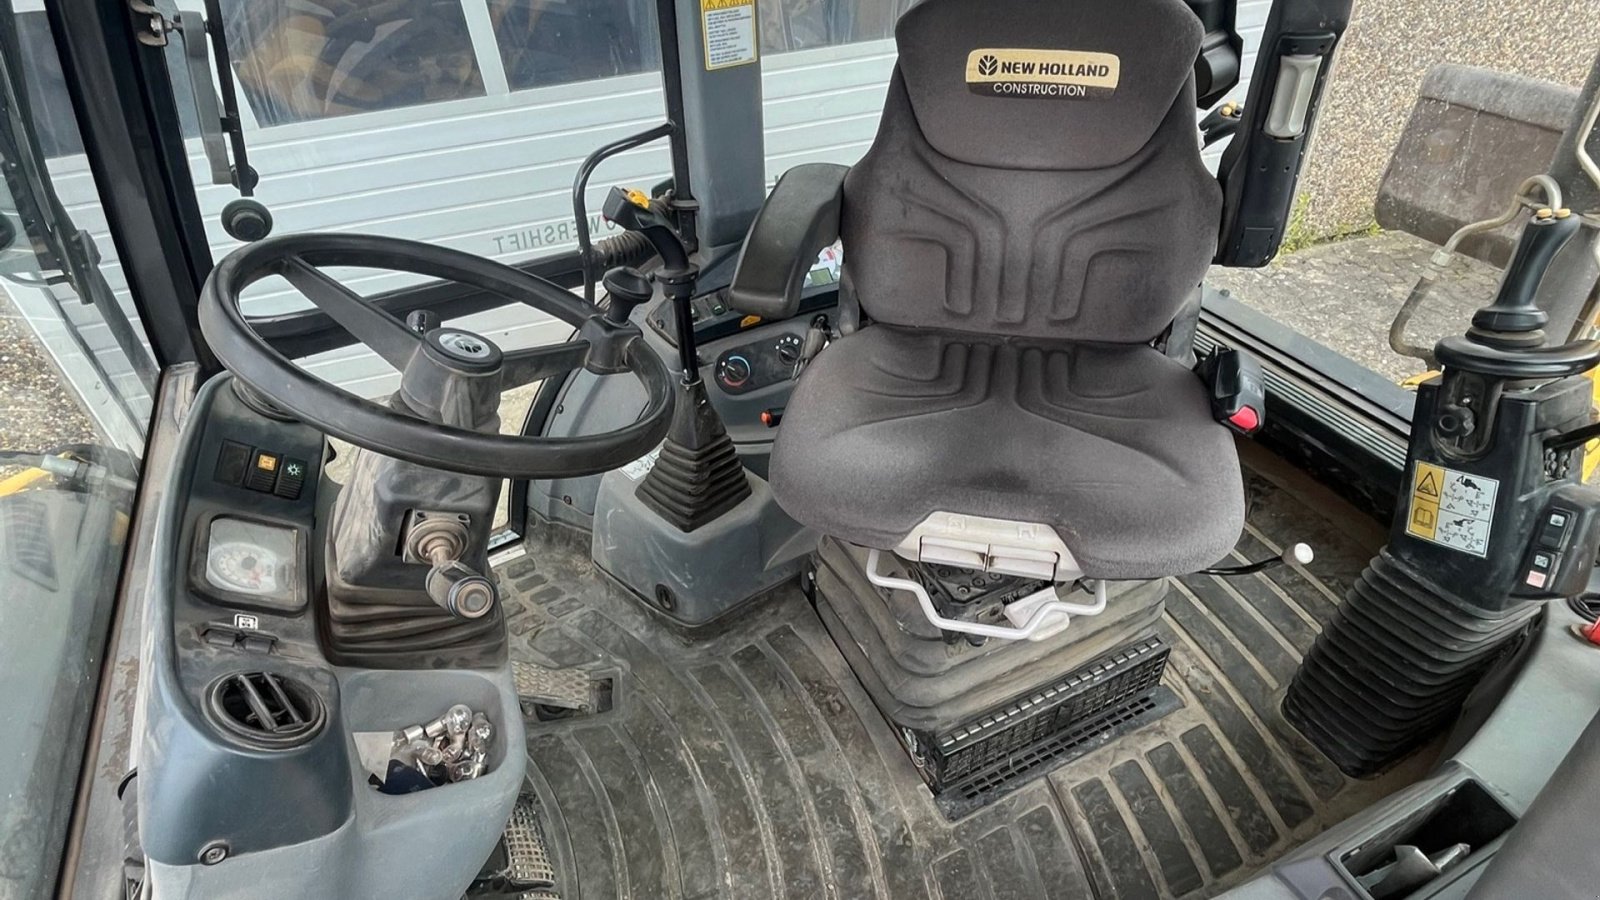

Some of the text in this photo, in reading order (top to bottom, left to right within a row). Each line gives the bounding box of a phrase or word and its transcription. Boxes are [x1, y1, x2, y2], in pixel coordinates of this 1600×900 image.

[1001, 62, 1110, 77] NEW HOLLAND
[993, 83, 1086, 97] CONSTRUCTION
